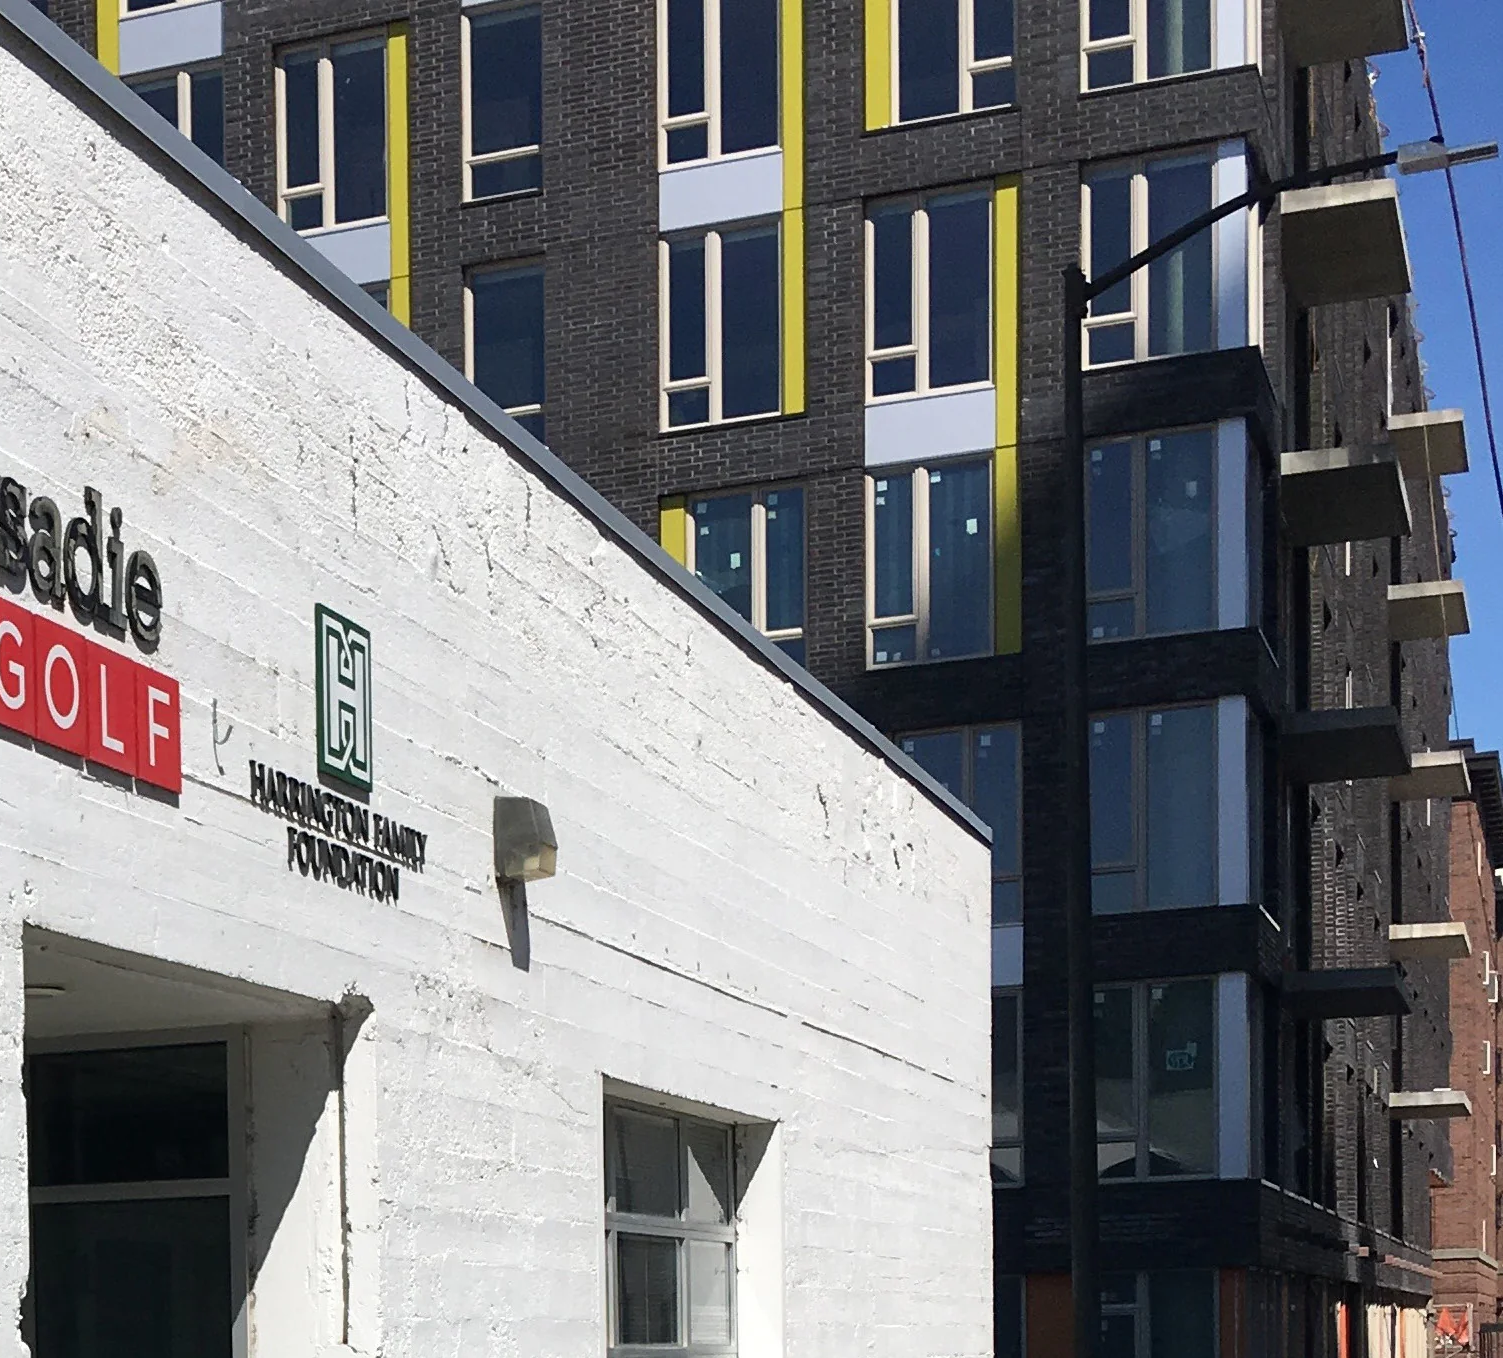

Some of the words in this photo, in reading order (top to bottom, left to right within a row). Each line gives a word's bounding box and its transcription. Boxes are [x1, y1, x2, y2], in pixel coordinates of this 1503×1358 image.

[249, 760, 370, 845] HARRINGTON
[373, 813, 428, 866] FAMILY
[287, 826, 400, 901] FOUNDATION
